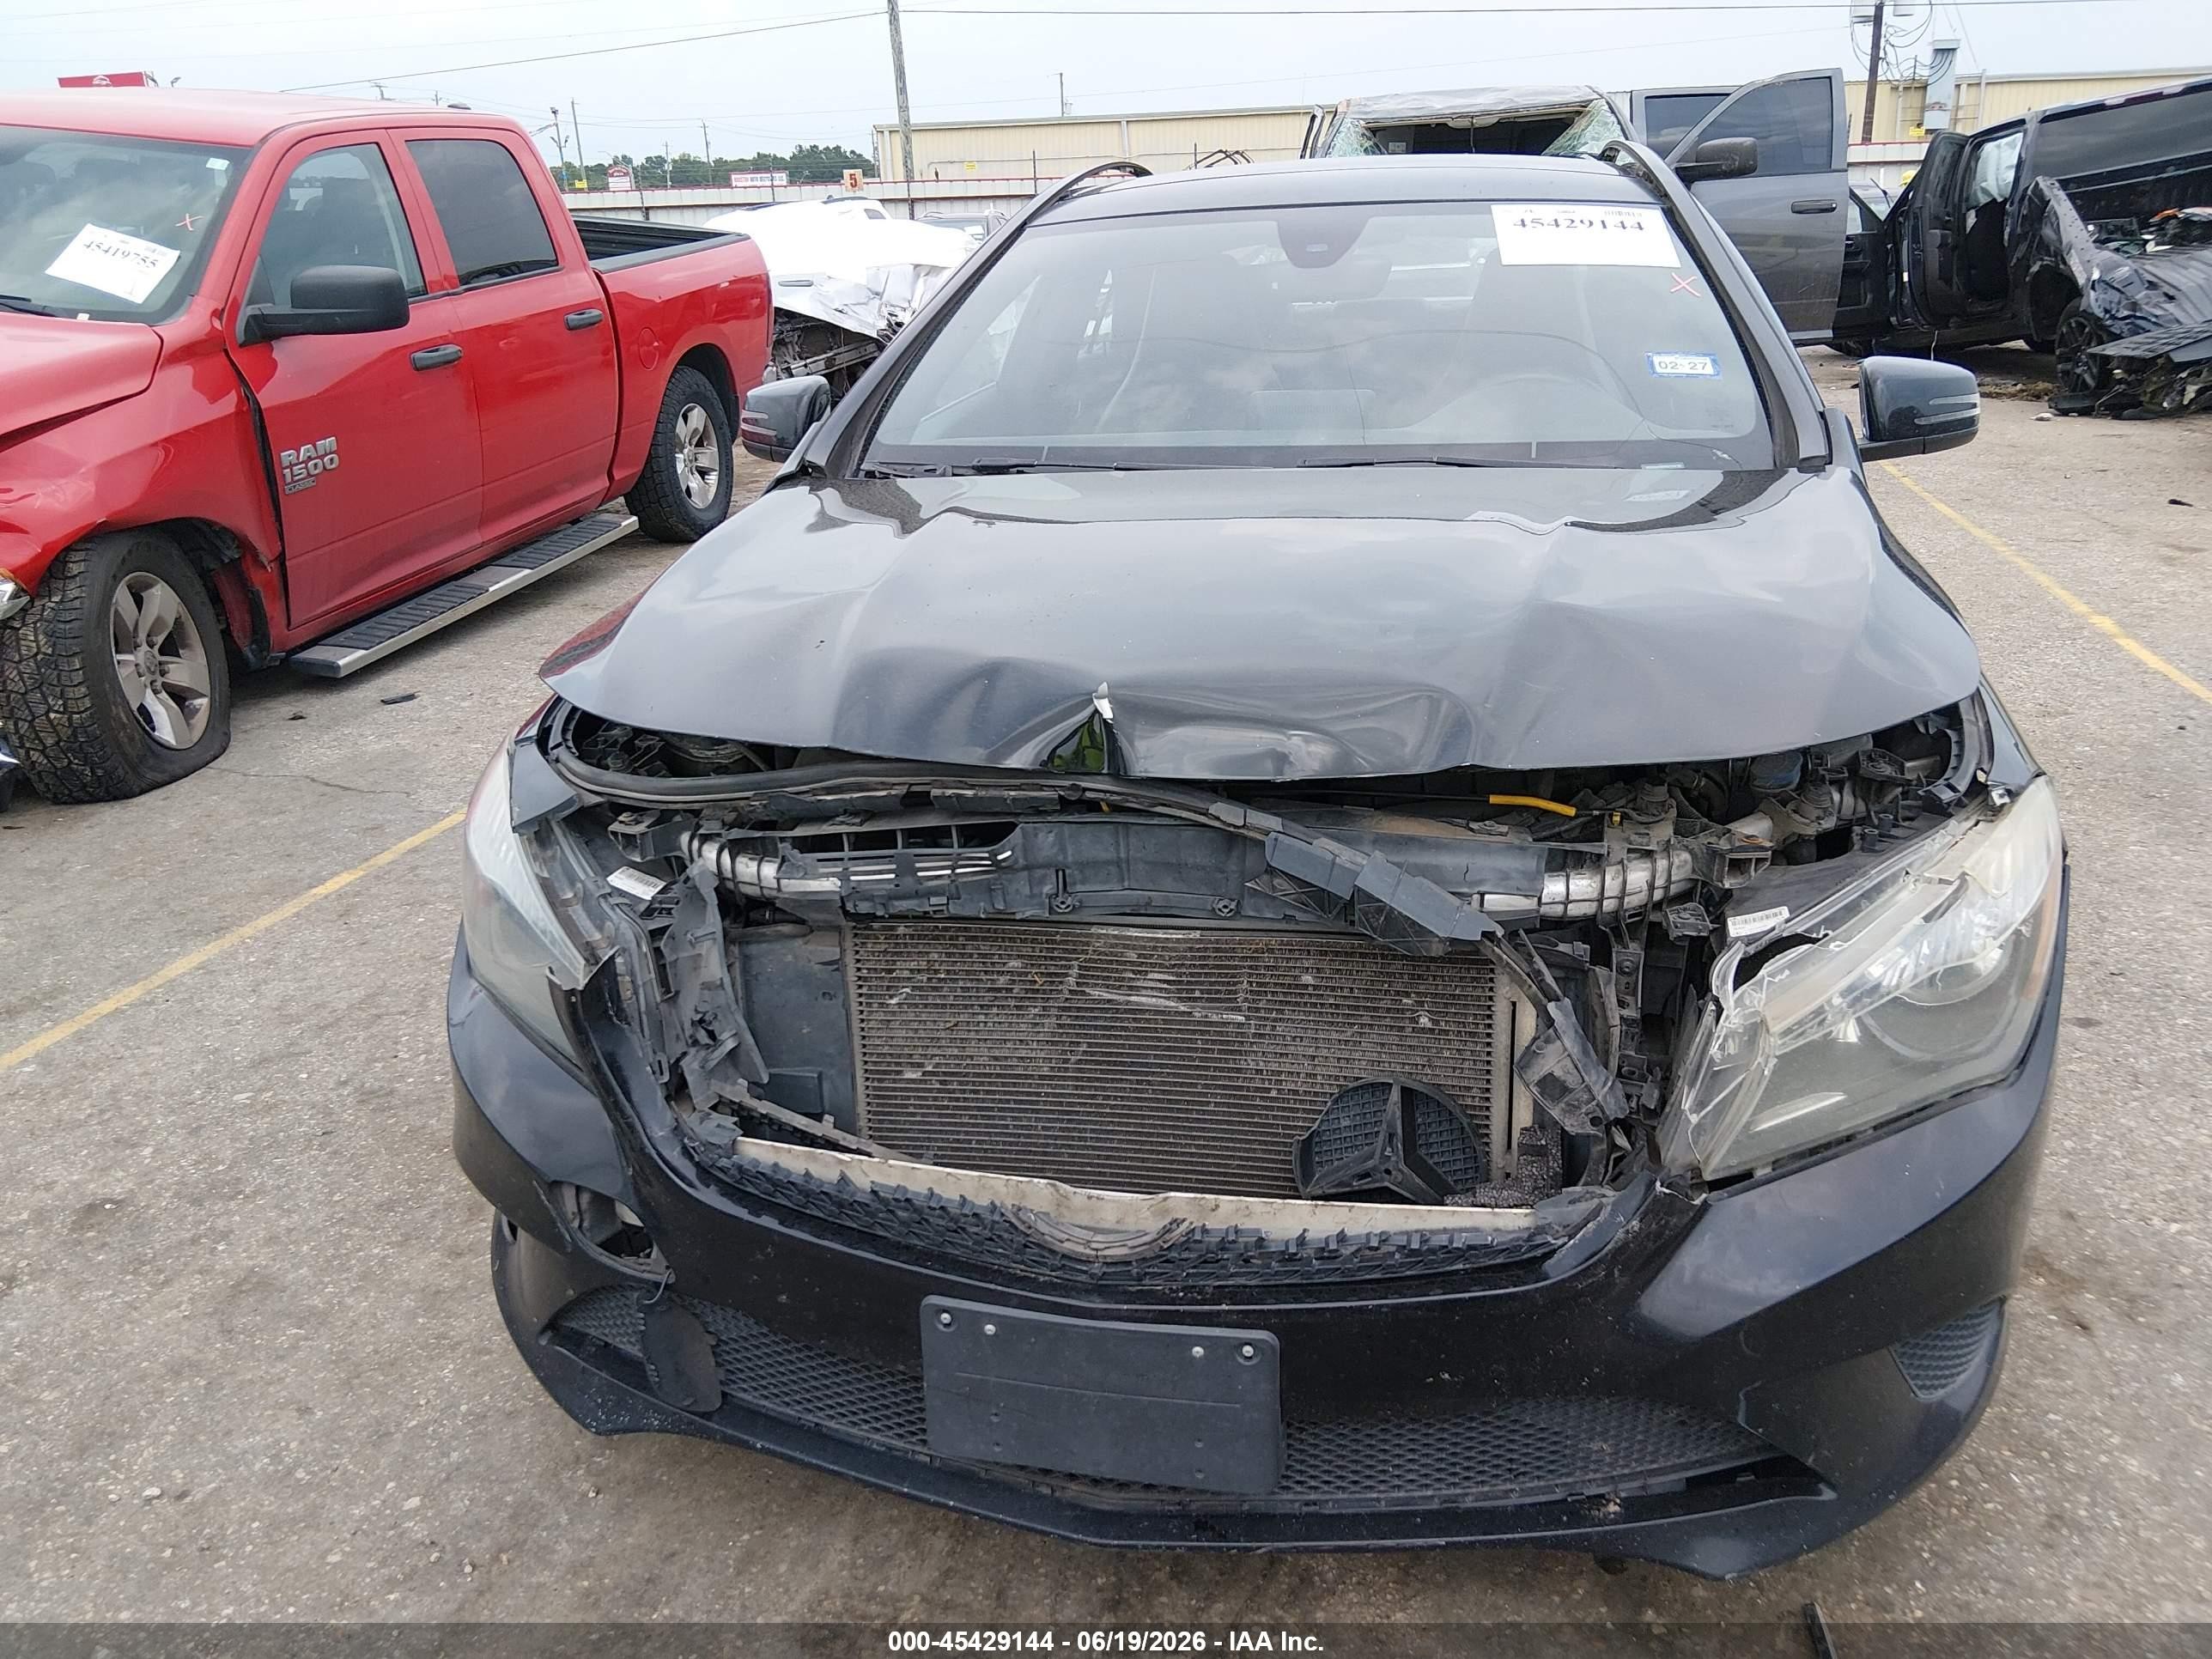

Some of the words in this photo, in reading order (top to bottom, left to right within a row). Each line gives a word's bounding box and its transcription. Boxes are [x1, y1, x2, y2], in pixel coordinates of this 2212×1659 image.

[849, 173, 859, 188] 5
[1513, 217, 1644, 231] 45429144
[83, 240, 159, 269] 45419755
[280, 436, 337, 468] RAM
[283, 453, 340, 484] 1500
